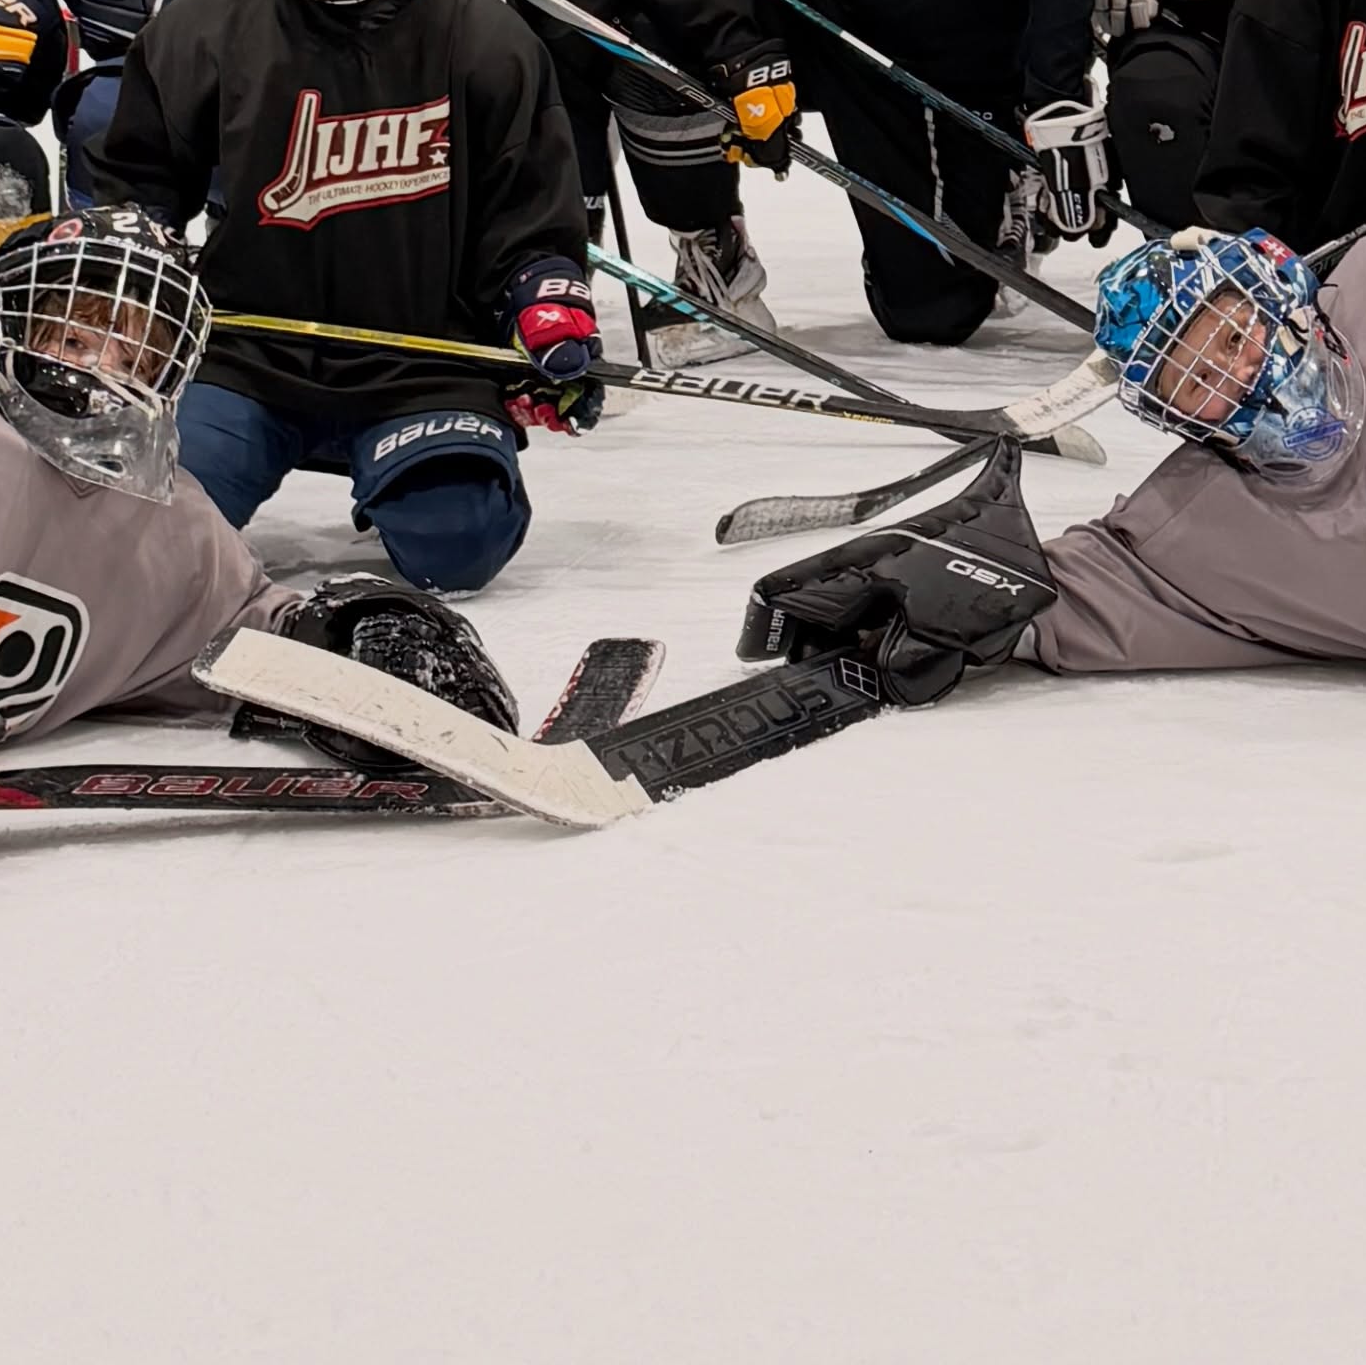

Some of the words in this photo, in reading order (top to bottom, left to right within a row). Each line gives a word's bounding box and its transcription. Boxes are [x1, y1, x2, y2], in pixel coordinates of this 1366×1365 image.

[313, 100, 450, 181] IJHF
[630, 368, 839, 411] BAUER
[373, 414, 503, 463] BAUER
[946, 559, 1025, 597] GSX
[766, 607, 787, 653] BAUER
[72, 775, 430, 801] BAUER
